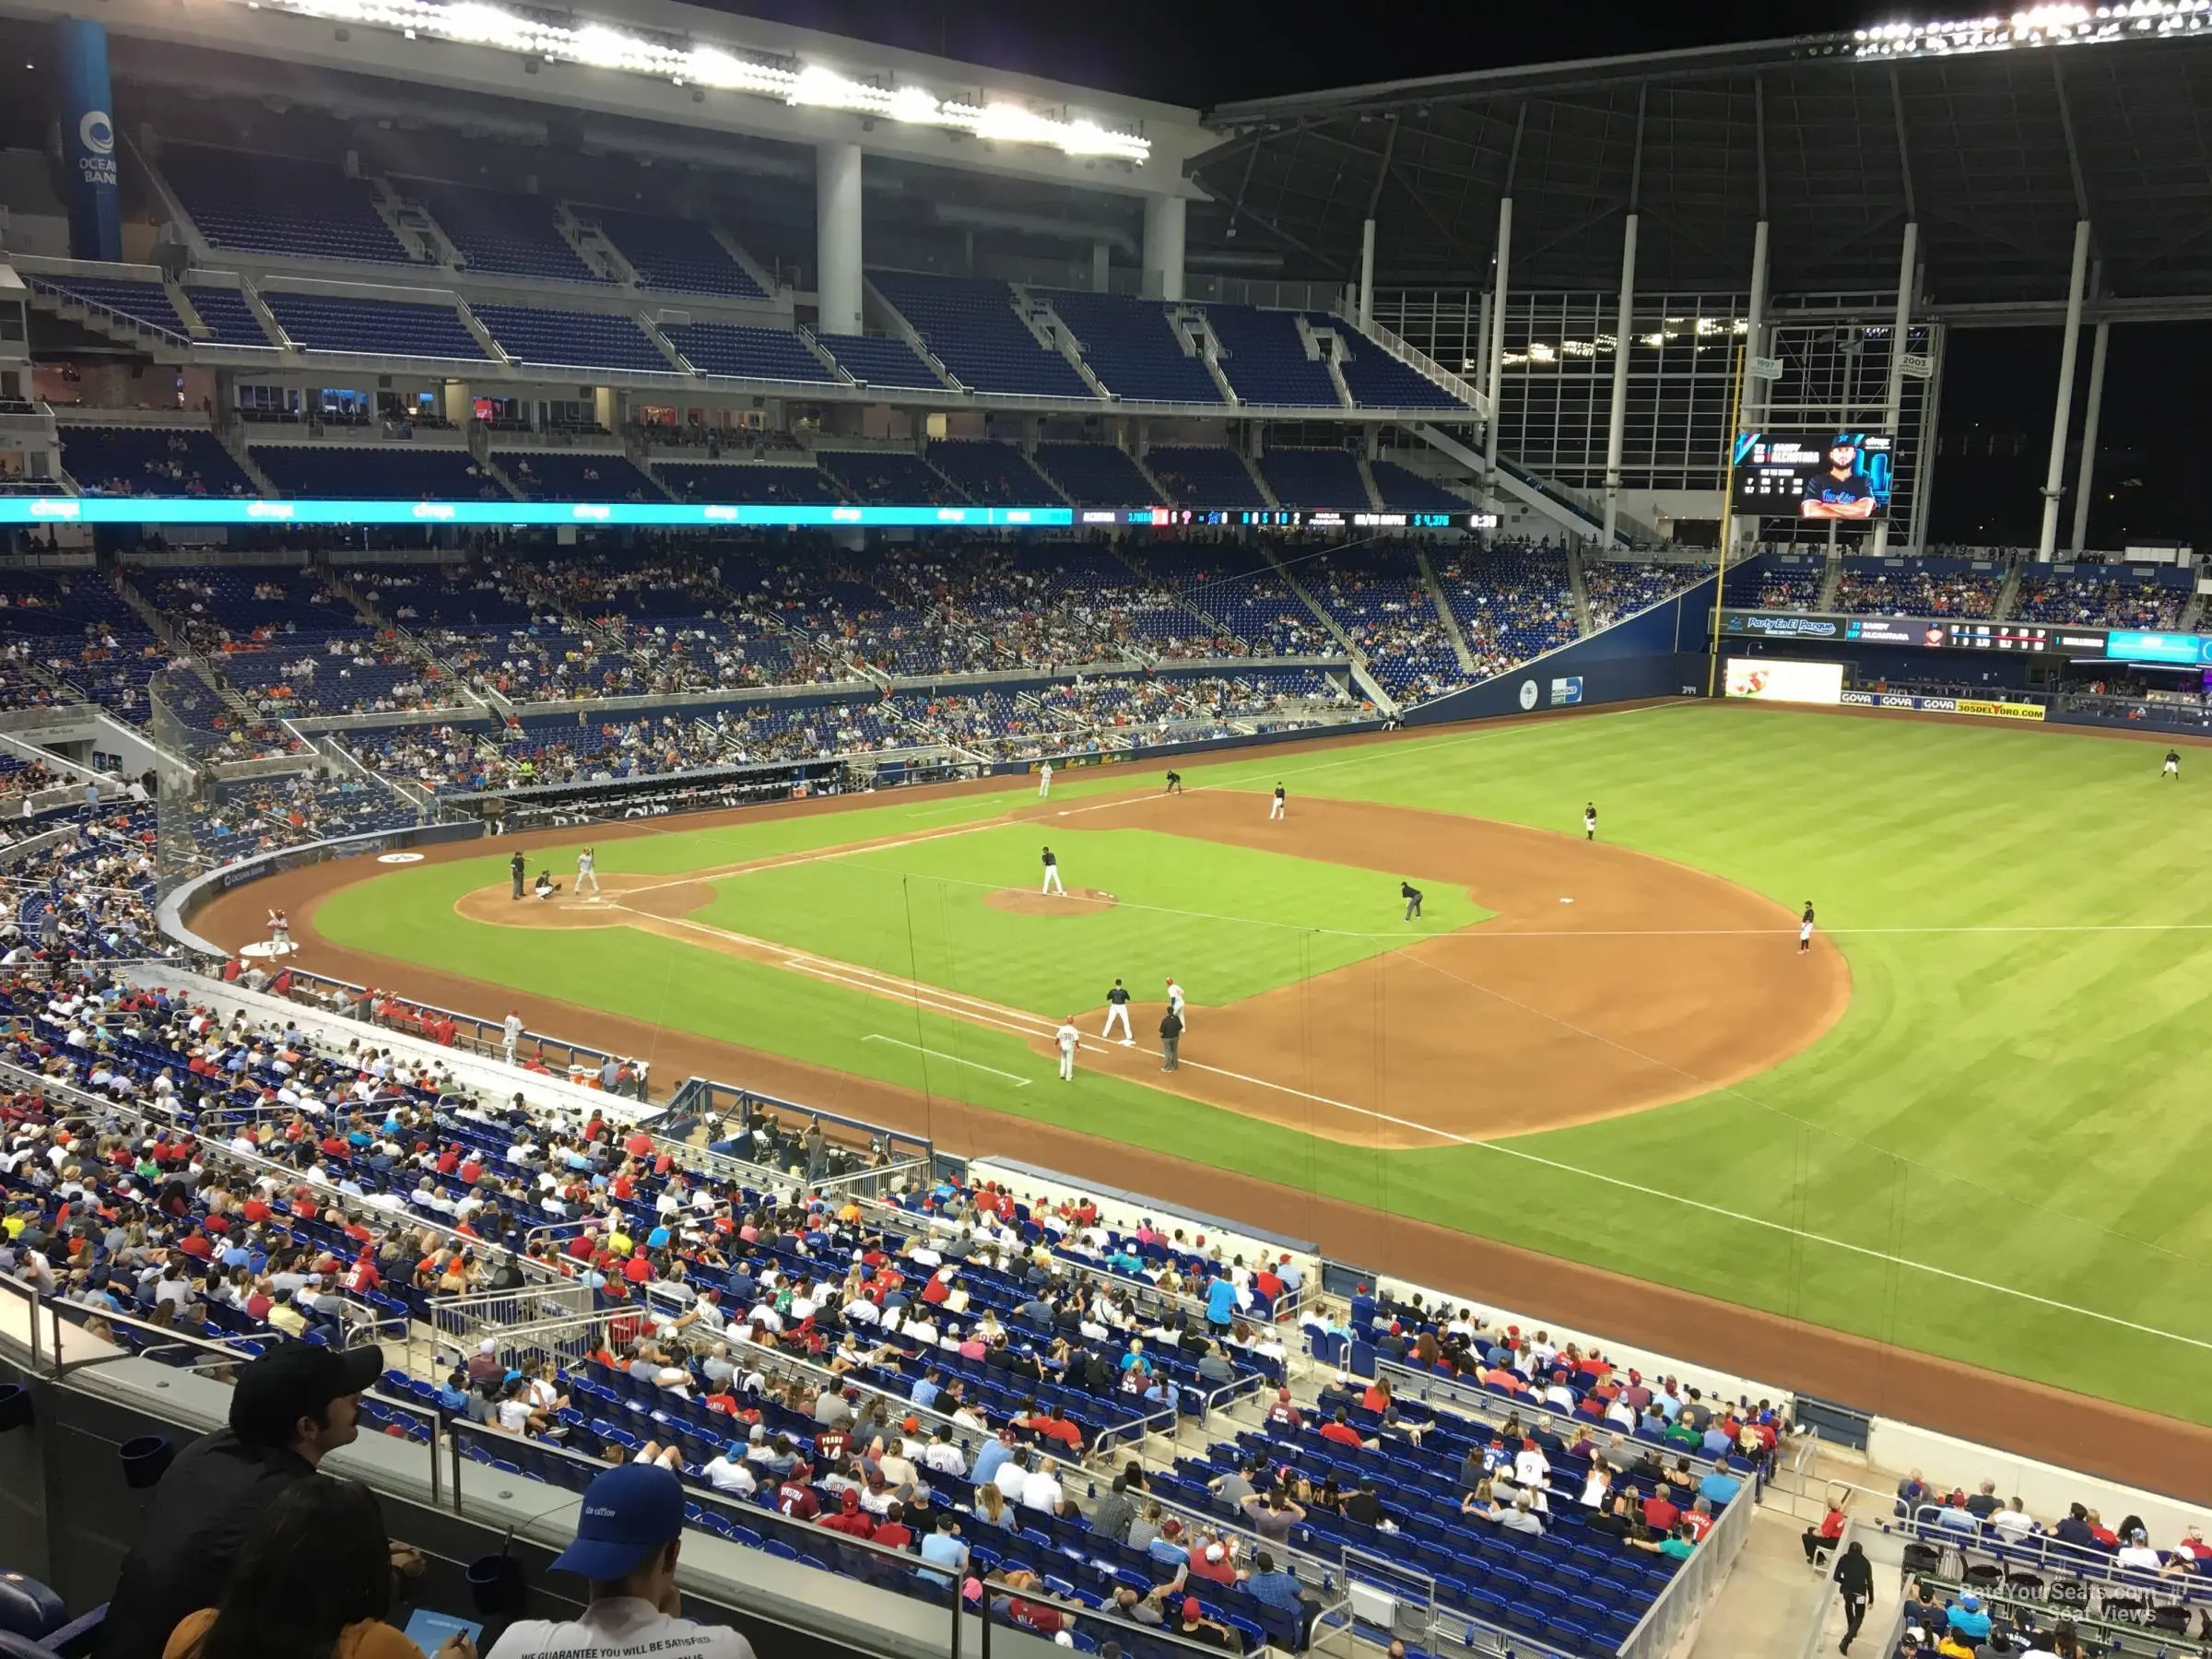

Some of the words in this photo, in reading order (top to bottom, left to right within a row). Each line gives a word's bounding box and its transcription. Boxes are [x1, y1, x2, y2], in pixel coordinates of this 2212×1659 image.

[1902, 357, 1926, 367] 2003
[1747, 618, 1775, 629] Party
[1775, 619, 1788, 628] En
[1798, 620, 1834, 632] Parque
[1841, 693, 1872, 703] GOYA
[1882, 696, 1912, 707] GOYA
[1924, 699, 1955, 711] GOYA
[1483, 1454, 1495, 1471] 3
[782, 1499, 793, 1518] 4
[538, 1648, 598, 1659] GUARANTEE
[601, 1648, 620, 1657] YOU
[623, 1644, 647, 1656] WILL
[649, 1641, 664, 1653] BE
